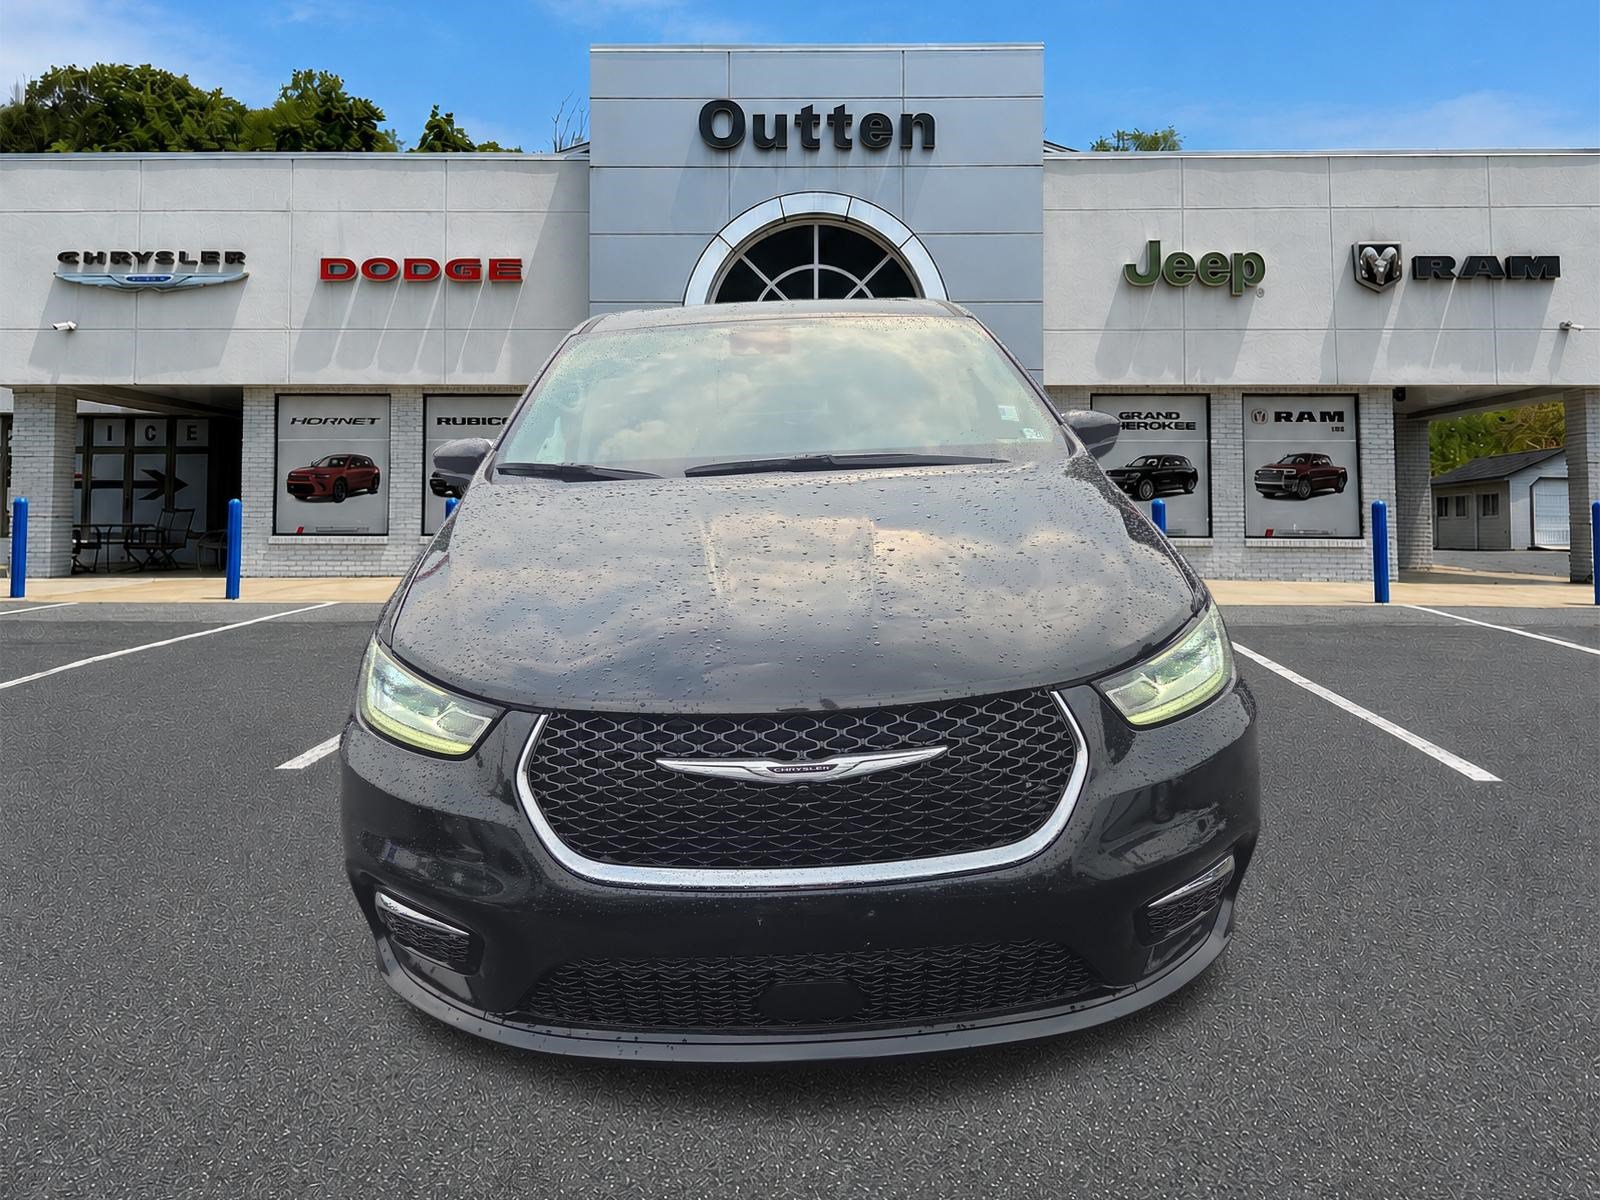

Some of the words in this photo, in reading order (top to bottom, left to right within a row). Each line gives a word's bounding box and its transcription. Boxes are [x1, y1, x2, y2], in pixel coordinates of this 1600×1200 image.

[699, 99, 936, 150] Outten
[56, 250, 246, 265] CHRYSLER
[320, 257, 523, 282] DODGE
[1123, 240, 1266, 296] Jeep
[1411, 256, 1561, 280] RAM
[290, 417, 380, 426] HORNET
[1118, 411, 1180, 420] GRAND
[1274, 411, 1345, 423] RAM
